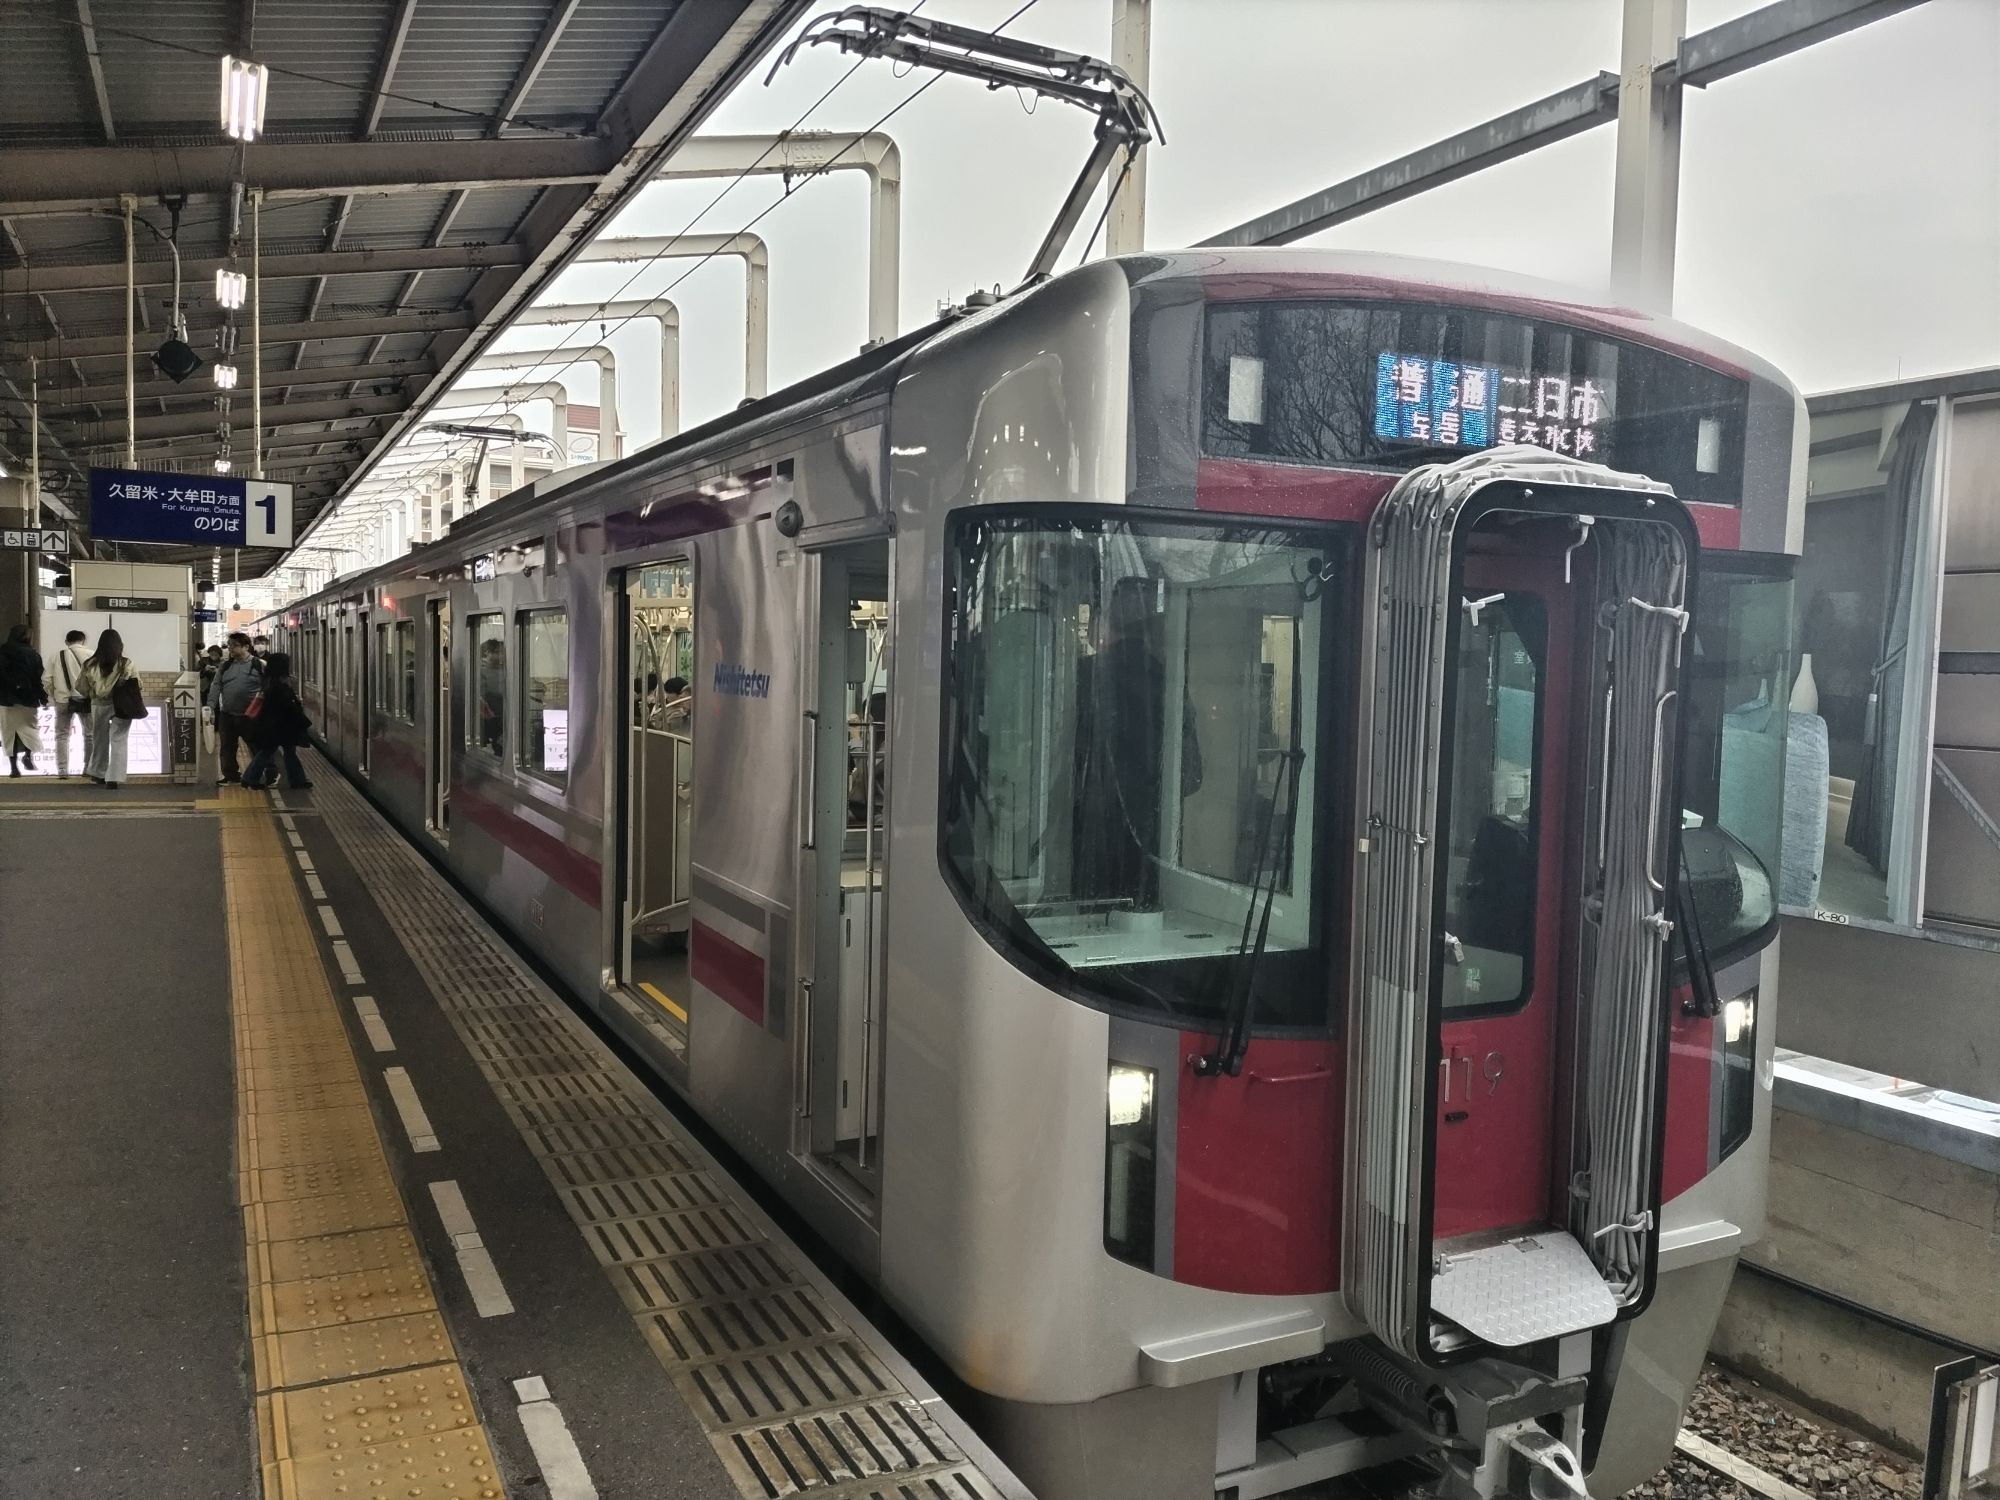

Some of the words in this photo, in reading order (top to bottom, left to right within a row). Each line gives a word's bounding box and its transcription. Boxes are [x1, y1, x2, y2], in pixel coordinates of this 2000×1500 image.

[1391, 360, 1484, 411] 普通
[1497, 376, 1605, 427] 二日市
[161, 503, 176, 511] For
[254, 495, 276, 534] 1
[194, 516, 240, 532] のりば
[180, 719, 191, 761] エレベーター
[1817, 911, 1847, 924] K-80
